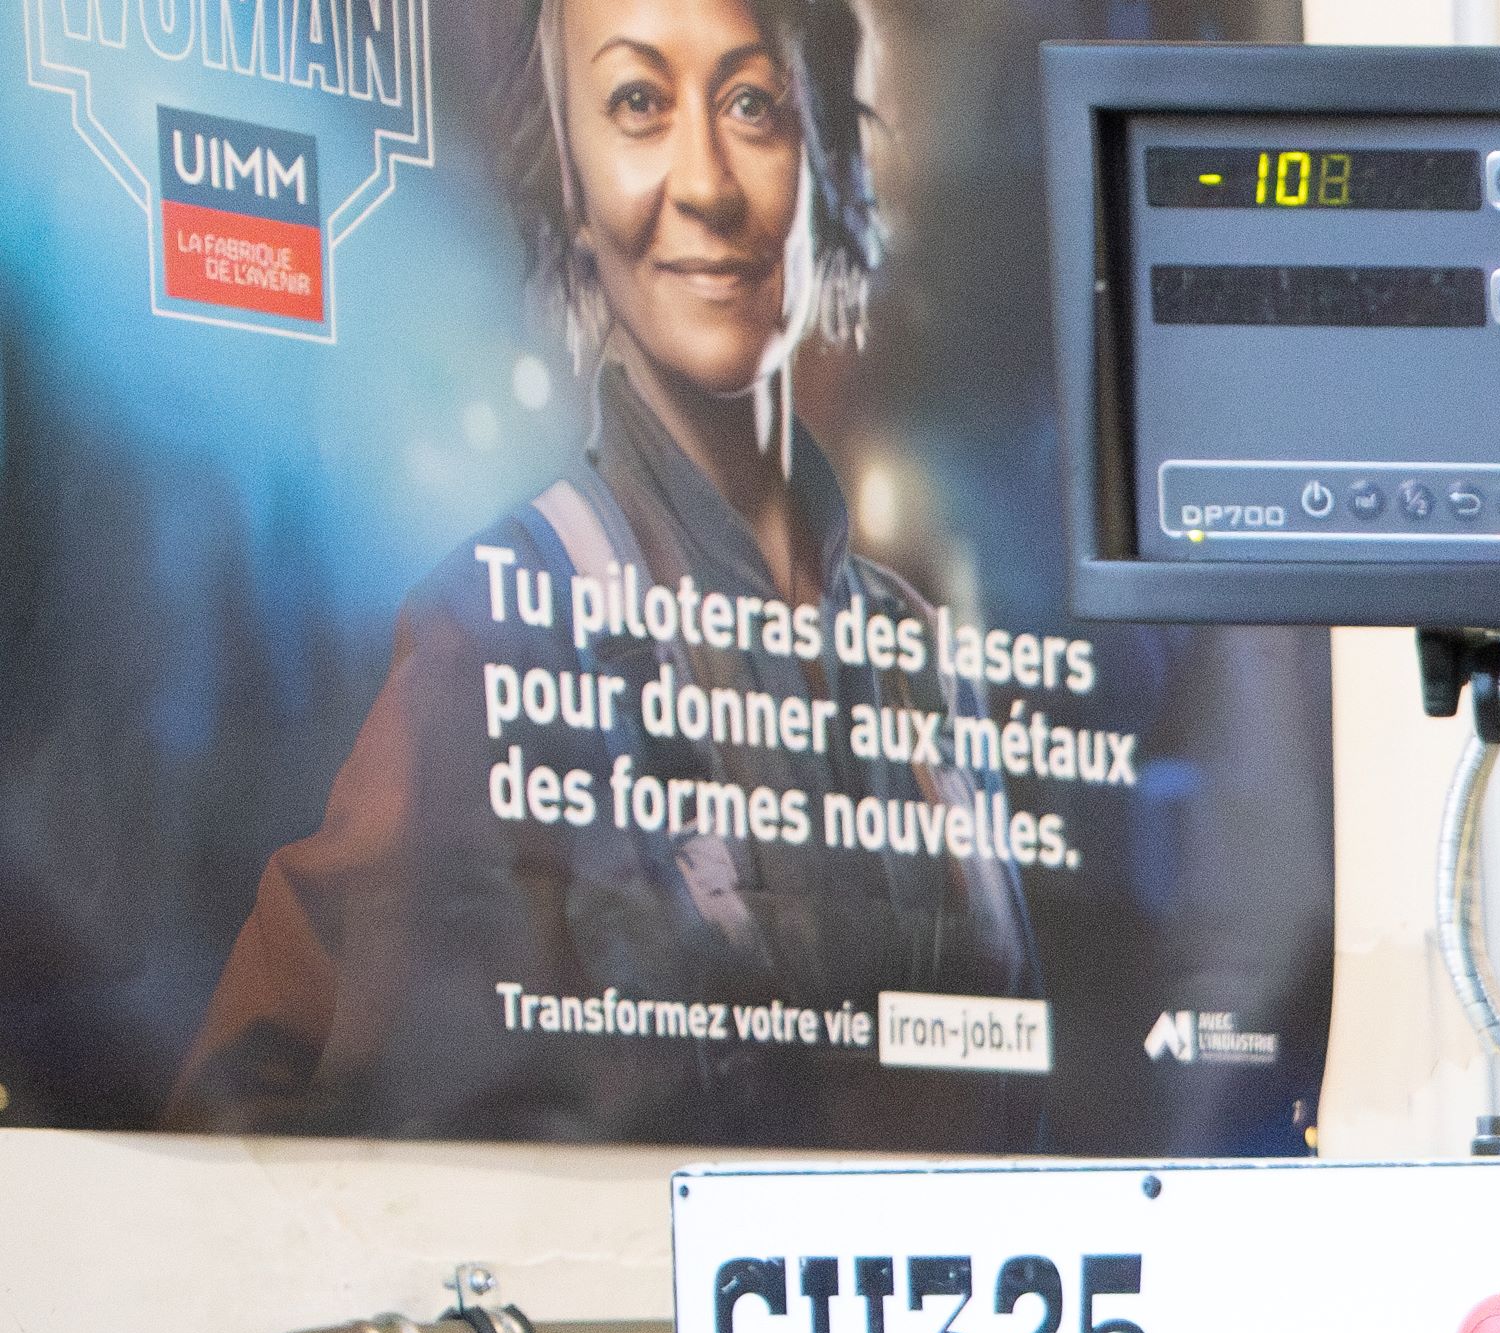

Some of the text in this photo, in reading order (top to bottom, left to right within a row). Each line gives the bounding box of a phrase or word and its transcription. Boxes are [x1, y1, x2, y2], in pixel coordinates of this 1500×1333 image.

[173, 129, 306, 205] UIMM
[177, 228, 202, 254] LA
[203, 233, 293, 271] FABRIQUE
[204, 256, 232, 283] DE
[233, 262, 312, 297] L'AVENIR
[1181, 504, 1286, 528] DP700
[475, 546, 1096, 695] Tu piloteras des lasers
[484, 663, 1138, 785] pour donner aux métaux
[488, 746, 1081, 870] des formes nouvelles.
[496, 981, 1040, 1058] Transformez votre vie iron-job.fr
